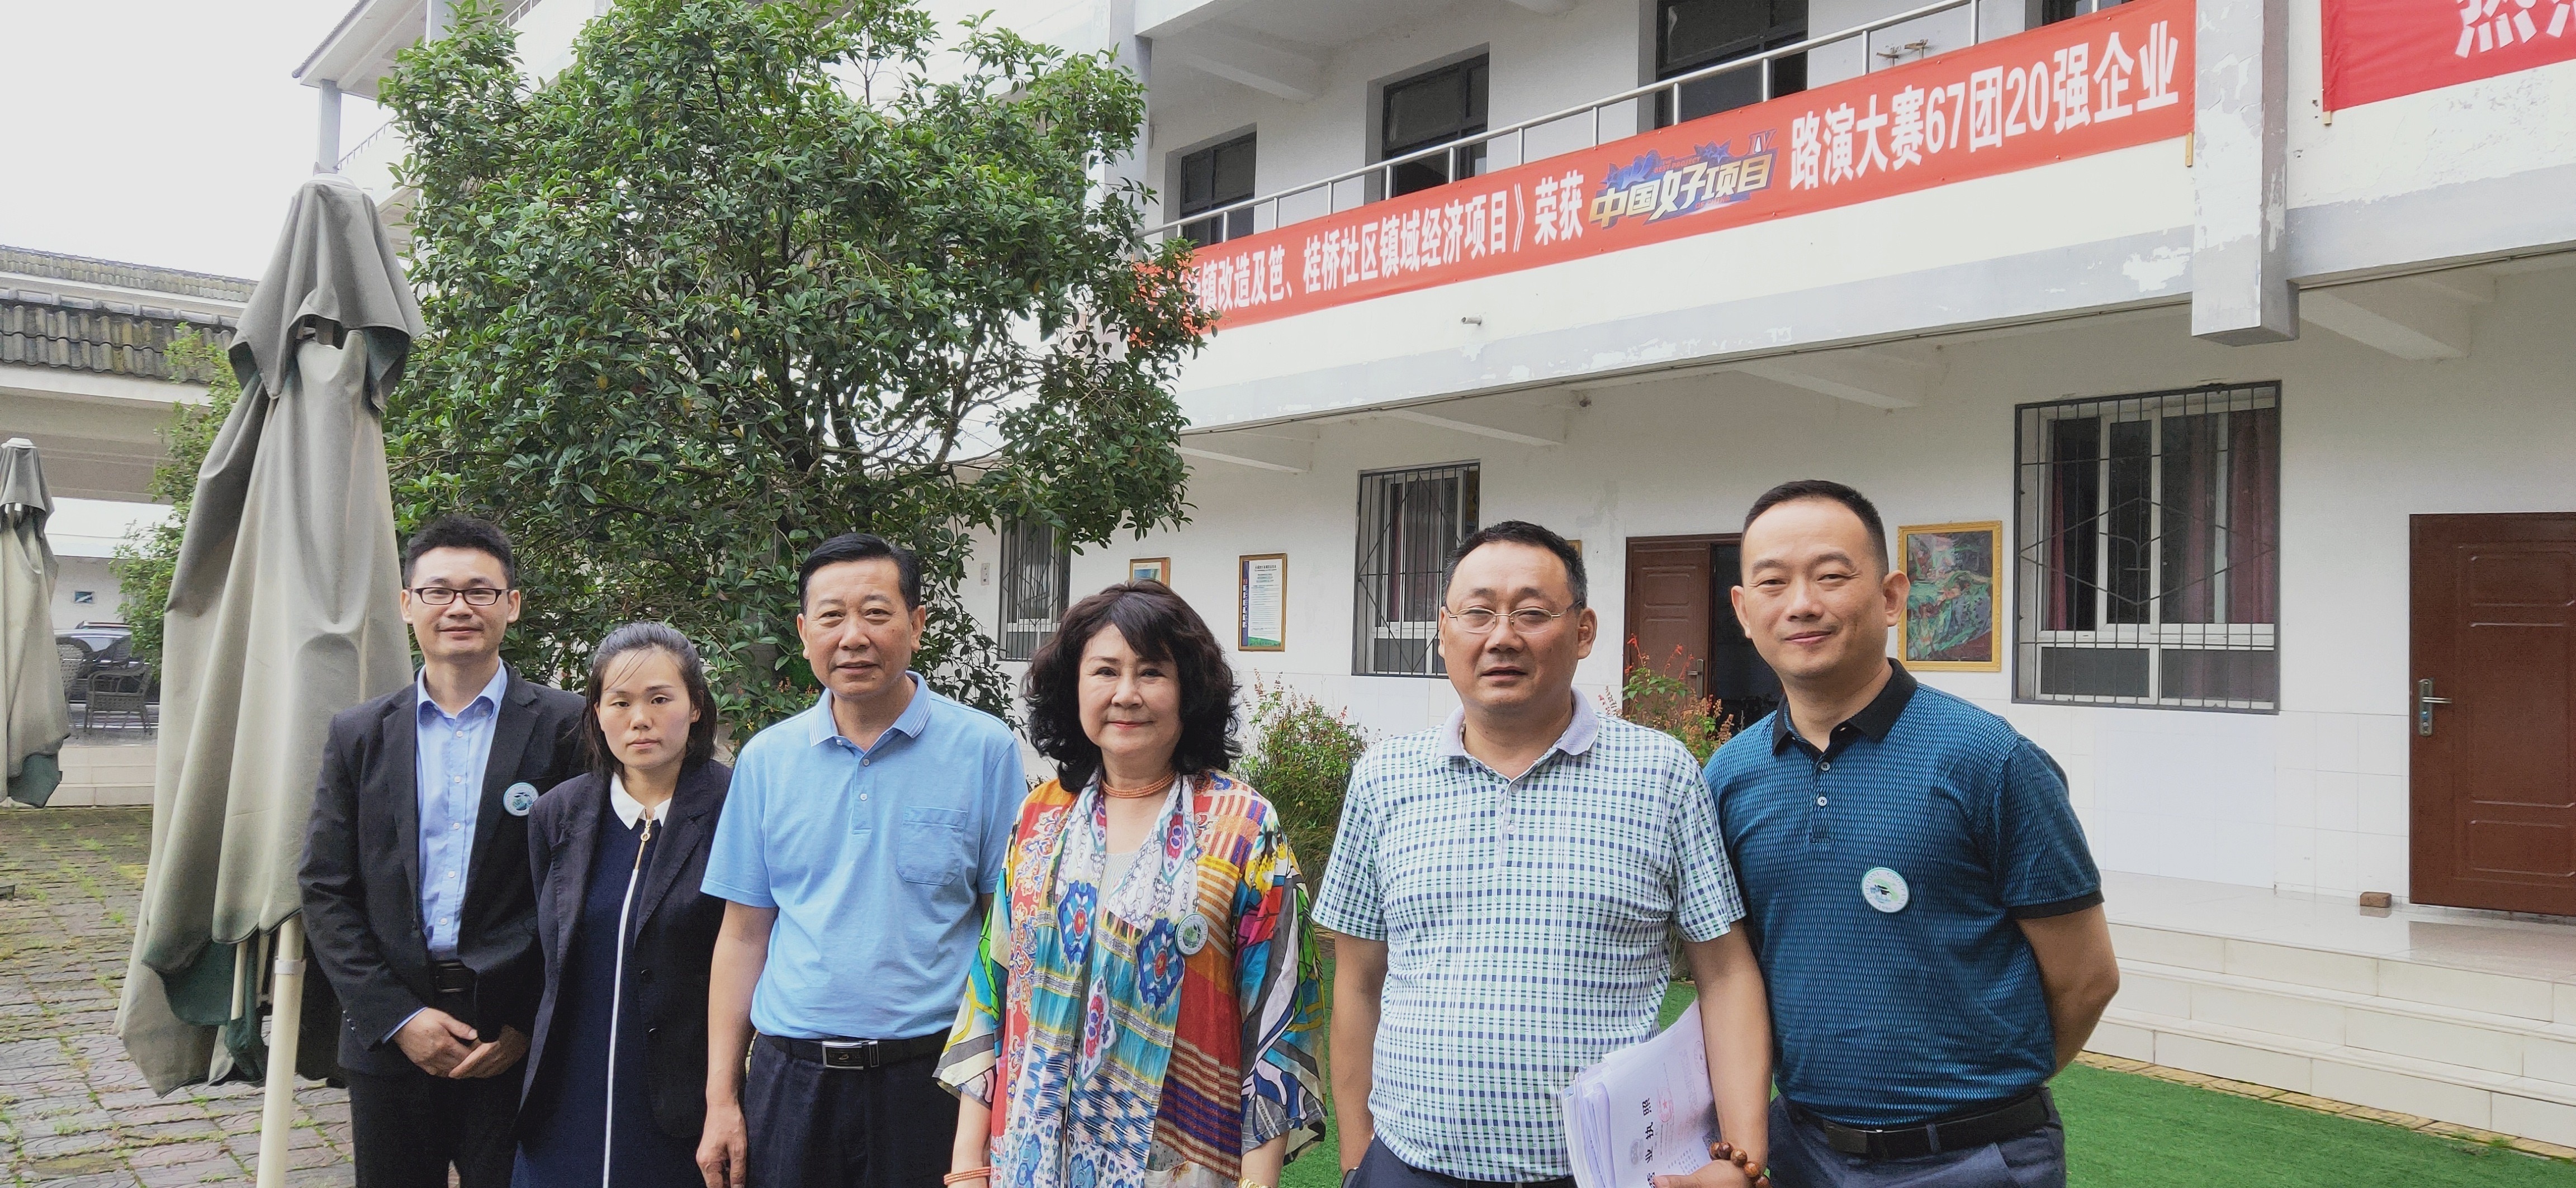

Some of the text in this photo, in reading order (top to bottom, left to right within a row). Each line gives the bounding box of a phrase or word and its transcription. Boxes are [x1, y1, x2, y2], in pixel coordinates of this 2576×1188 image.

[1589, 154, 1773, 228] 中国好项目
[1790, 20, 2179, 191] 路演大赛67团20强企业
[1671, 156, 1701, 168] PROJECT
